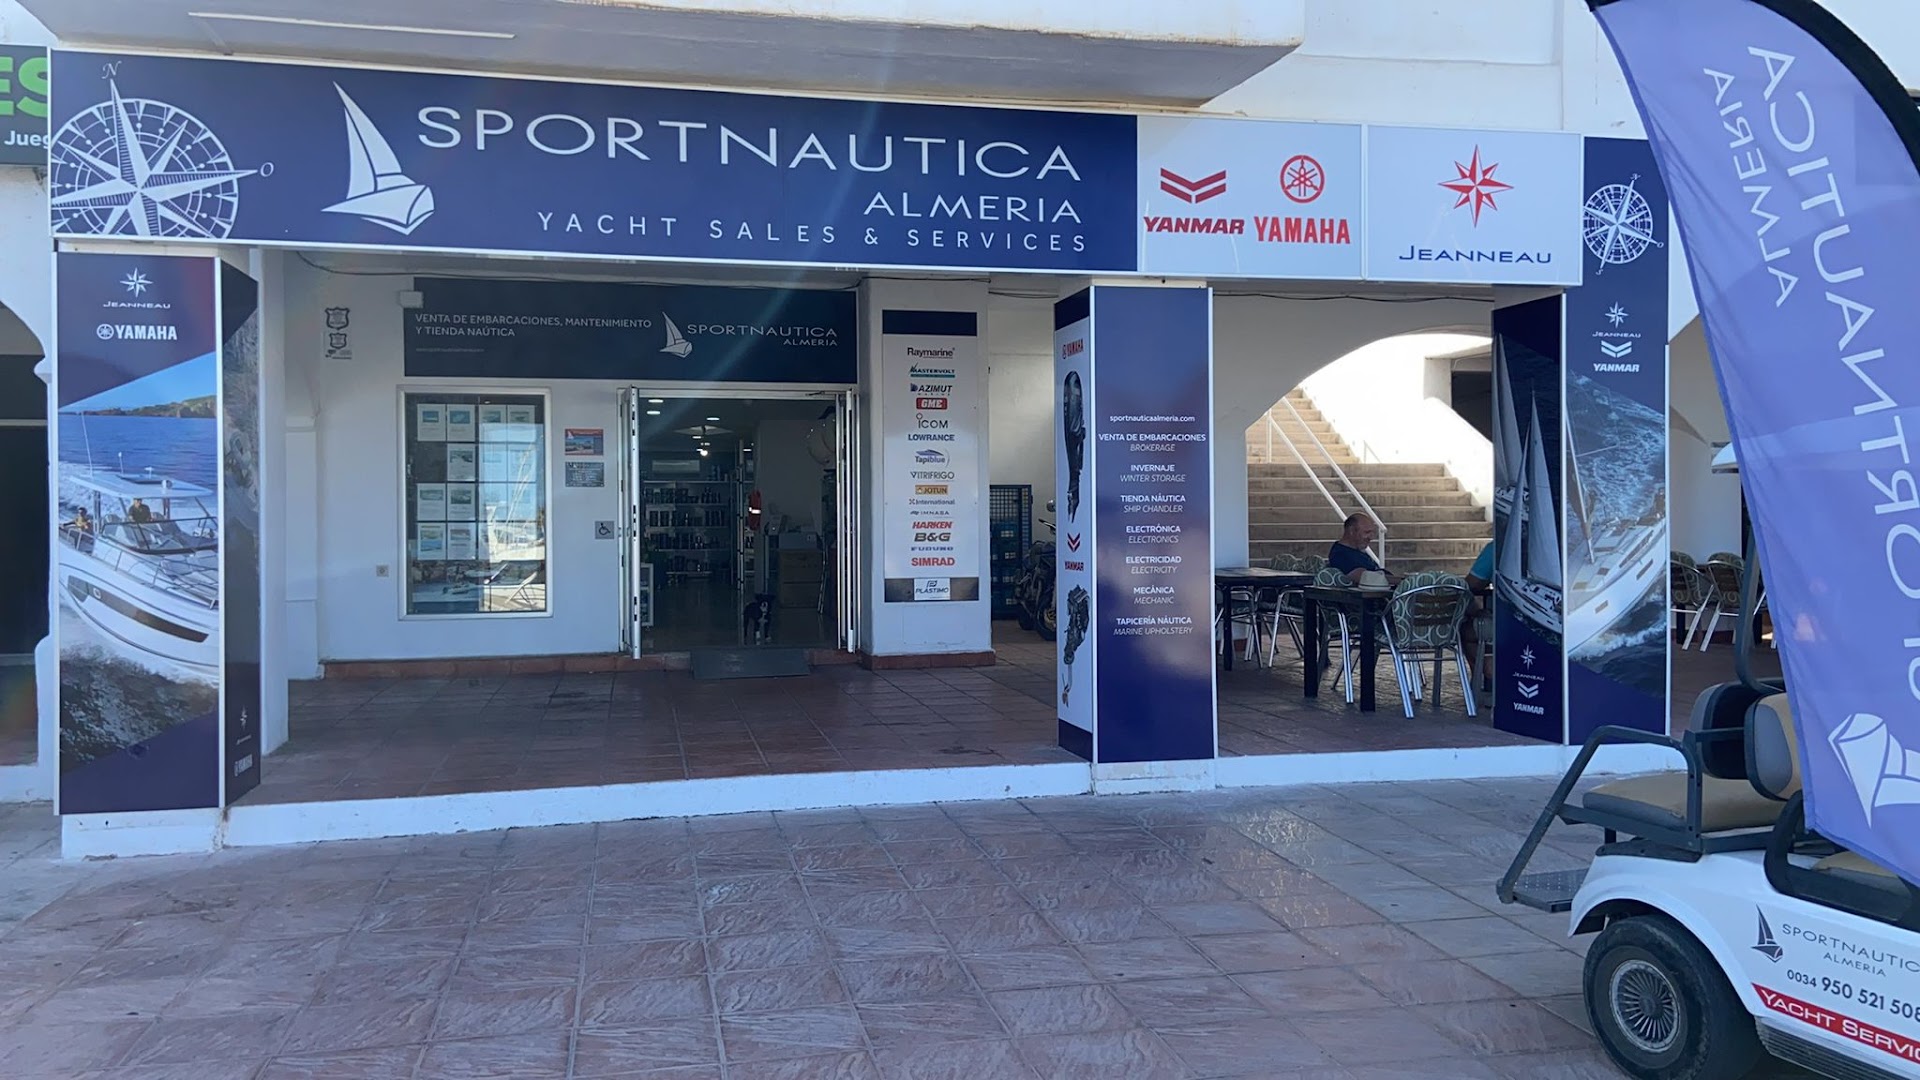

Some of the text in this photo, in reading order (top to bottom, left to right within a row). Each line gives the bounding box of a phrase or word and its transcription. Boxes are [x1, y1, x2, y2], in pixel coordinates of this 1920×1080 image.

[418, 106, 1081, 181] SPORTNAUTICA
[863, 191, 1082, 224] ALMERIA
[1143, 216, 1245, 235] YANMAR
[1254, 216, 1350, 244] YAMAHA
[537, 211, 1086, 252] YACHT SALES & SERVICES
[1399, 245, 1551, 263] JEANNEAU
[416, 313, 652, 328] VENTA DE EMBARCACIONES, MANTENIMIENTO
[115, 324, 178, 340] YAMAHA
[416, 325, 515, 337] Y TIENDA NAÚTICA
[687, 324, 837, 337] SPORTNAUTICA
[907, 347, 953, 357] Raymarine
[1593, 363, 1640, 373] YANMAR
[918, 385, 952, 393] AZIMUT
[920, 399, 943, 408] GME
[1109, 415, 1195, 423] sportnauticaalmeria.com
[1098, 433, 1206, 441] VENTA DE EMBARCACIONES
[1130, 444, 1175, 452] BROKERAGE
[915, 455, 945, 464] Tapiblue
[1130, 464, 1175, 472] INVERNAJE
[910, 471, 955, 479] VITRIFRIGO
[1120, 474, 1186, 482] WINTER STORAGE
[1151, 493, 1186, 502] NÁUTICA
[1123, 505, 1183, 513] SHIP CHANDLER
[912, 521, 952, 529] HARKEN
[1126, 524, 1181, 533] ELECTRÓNICA
[914, 532, 951, 542] B&G
[1128, 535, 1179, 544] ELECTRONICS
[911, 557, 955, 566] SIMRAD
[1126, 556, 1181, 564] ELECTRICIDAD
[1131, 566, 1178, 574] ELECTRICITY
[1133, 585, 1174, 594] MECÁNICA
[1133, 596, 1174, 605] MECHANIC
[1116, 615, 1192, 625] TAPICERÍA NÁUTICA
[1113, 627, 1193, 635] MARINE UPHOLSTERY
[1513, 702, 1544, 715] YANMAR
[1823, 952, 1886, 977] ALMERIA
[1787, 969, 1817, 988] 0034
[1821, 976, 1853, 999] 950
[1857, 988, 1884, 1010] 521
[1760, 989, 1836, 1028] YACHT
